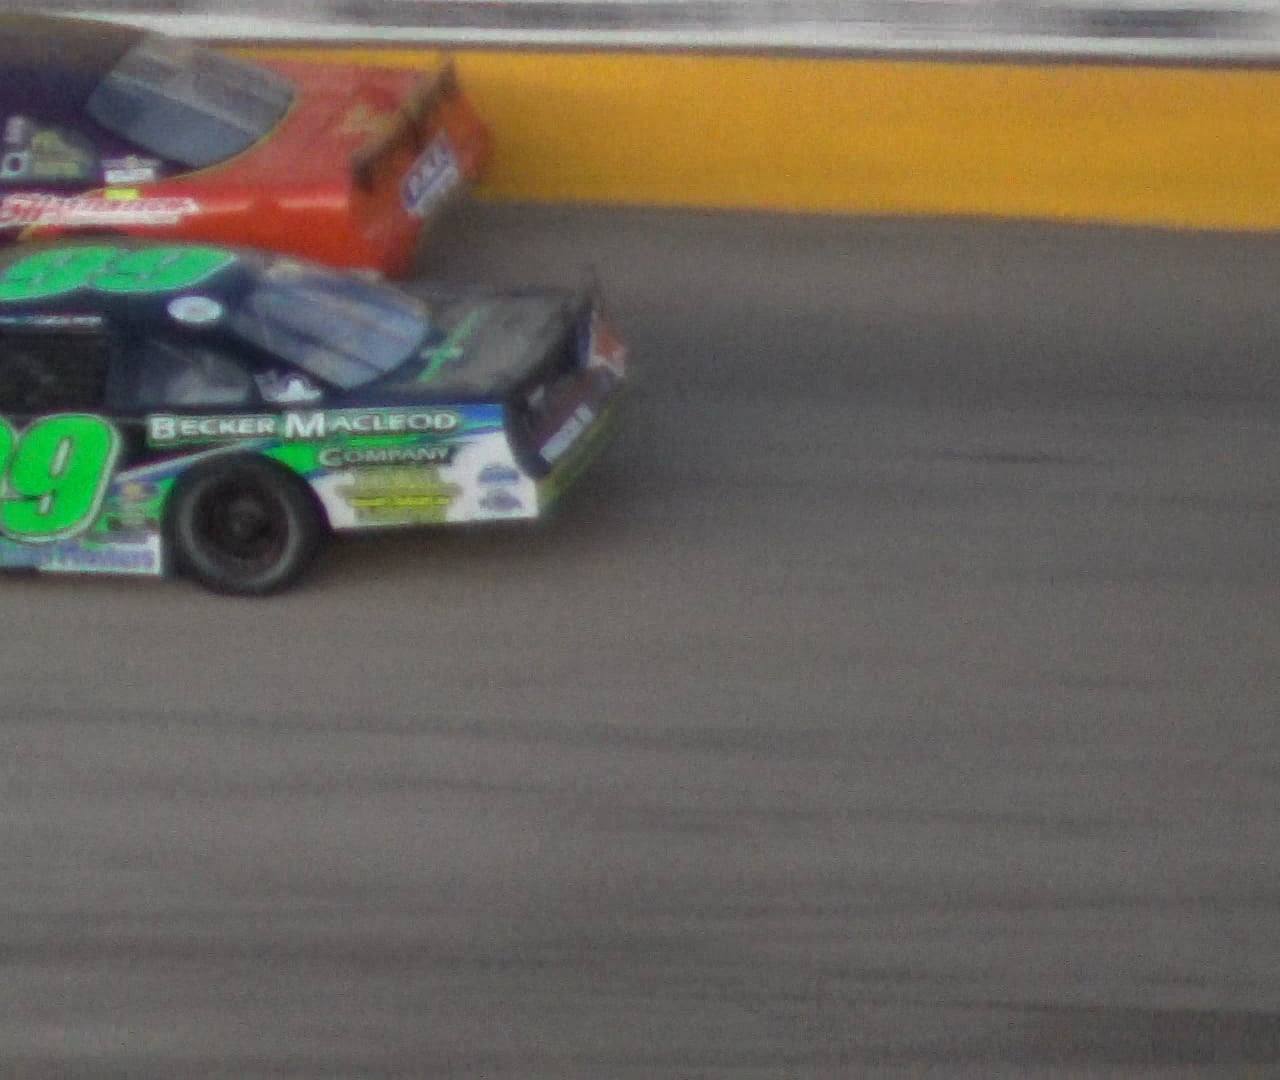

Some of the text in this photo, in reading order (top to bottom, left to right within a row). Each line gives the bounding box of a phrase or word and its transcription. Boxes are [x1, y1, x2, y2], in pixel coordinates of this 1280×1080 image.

[149, 411, 458, 441] BECKER MACLEOD
[319, 445, 451, 467] COMPANY
